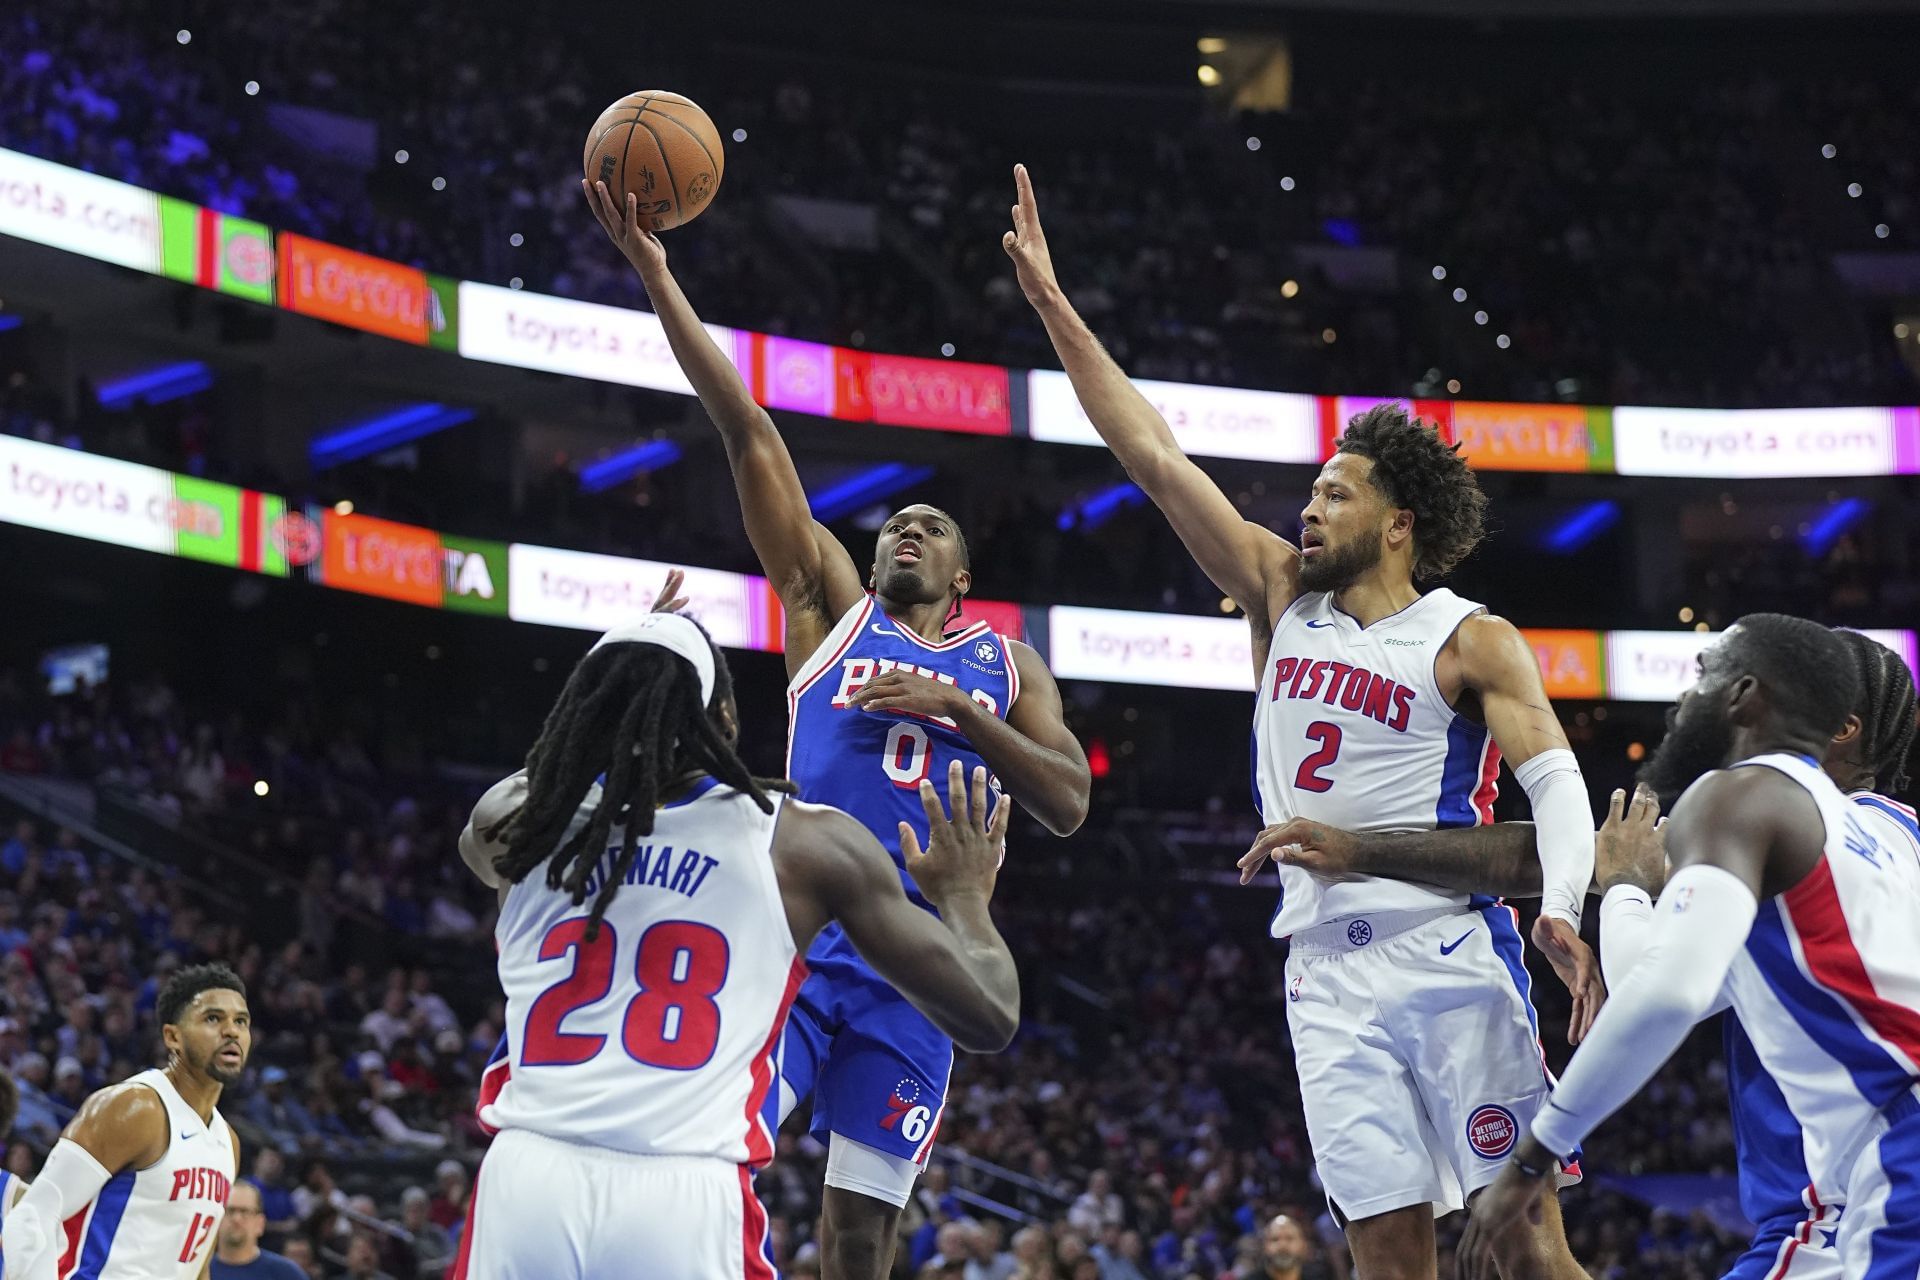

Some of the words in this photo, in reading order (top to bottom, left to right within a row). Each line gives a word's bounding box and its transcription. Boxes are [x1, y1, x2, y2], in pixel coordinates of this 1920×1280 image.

[1422, 413, 1595, 458] OYOTA
[1658, 427, 1878, 462] toyotacom
[961, 658, 1004, 676] crypto.com
[1272, 657, 1416, 732] PISTONS
[882, 721, 932, 789] 0
[1294, 721, 1342, 793] 2
[520, 916, 730, 1071] 28
[879, 1091, 931, 1142] 76
[1474, 1119, 1506, 1136] DETROIT
[1477, 1128, 1509, 1145] PISTONS
[178, 1212, 215, 1263] 12
